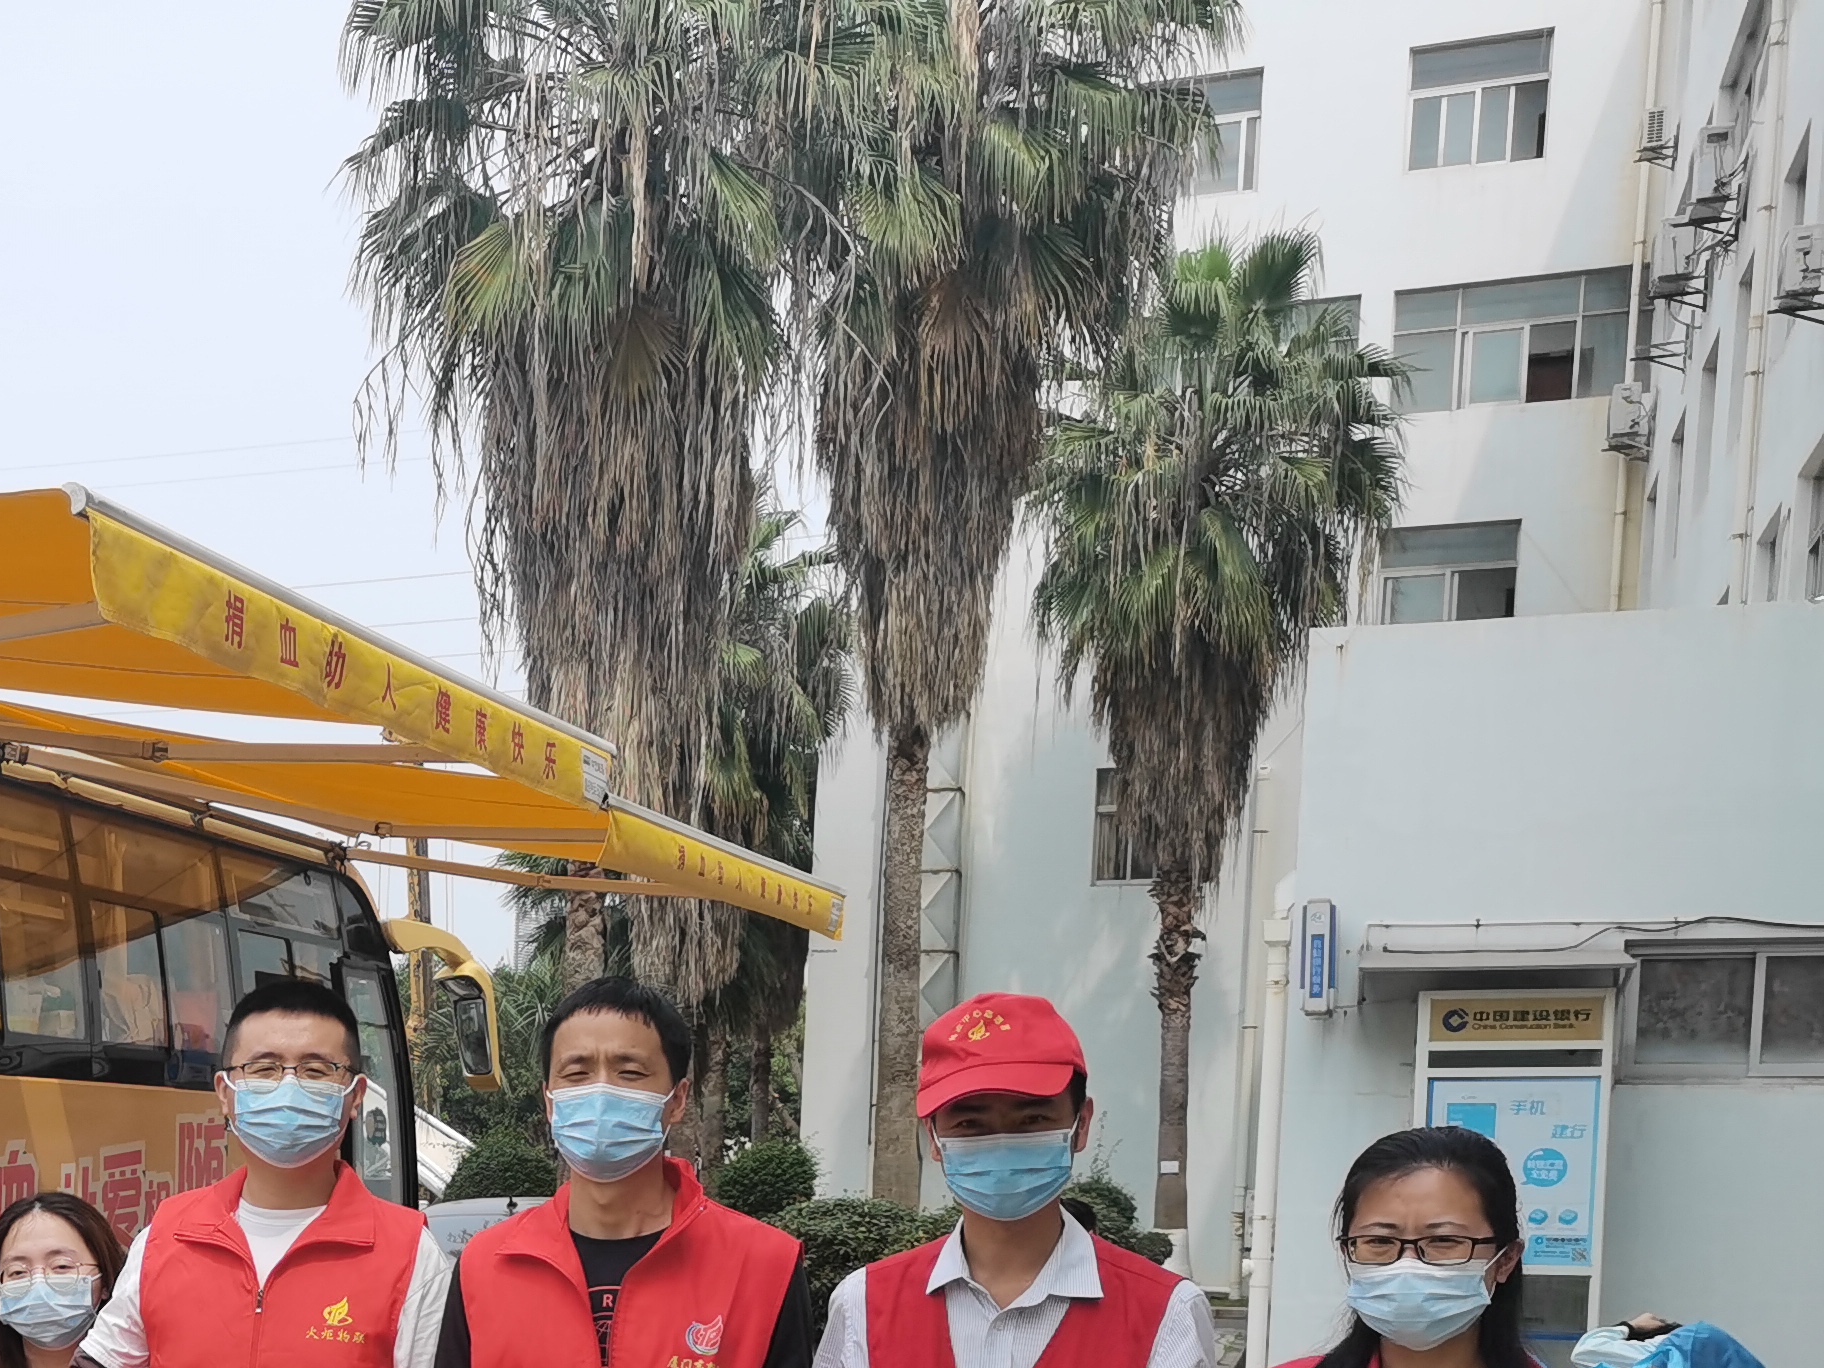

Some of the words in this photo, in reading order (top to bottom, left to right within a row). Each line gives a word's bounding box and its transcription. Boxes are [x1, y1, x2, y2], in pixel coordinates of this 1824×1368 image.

[223, 589, 558, 781] 捐血助人健康快乐
[1472, 1008, 1593, 1022] 中国建设银行
[1510, 1099, 1546, 1115] 手机
